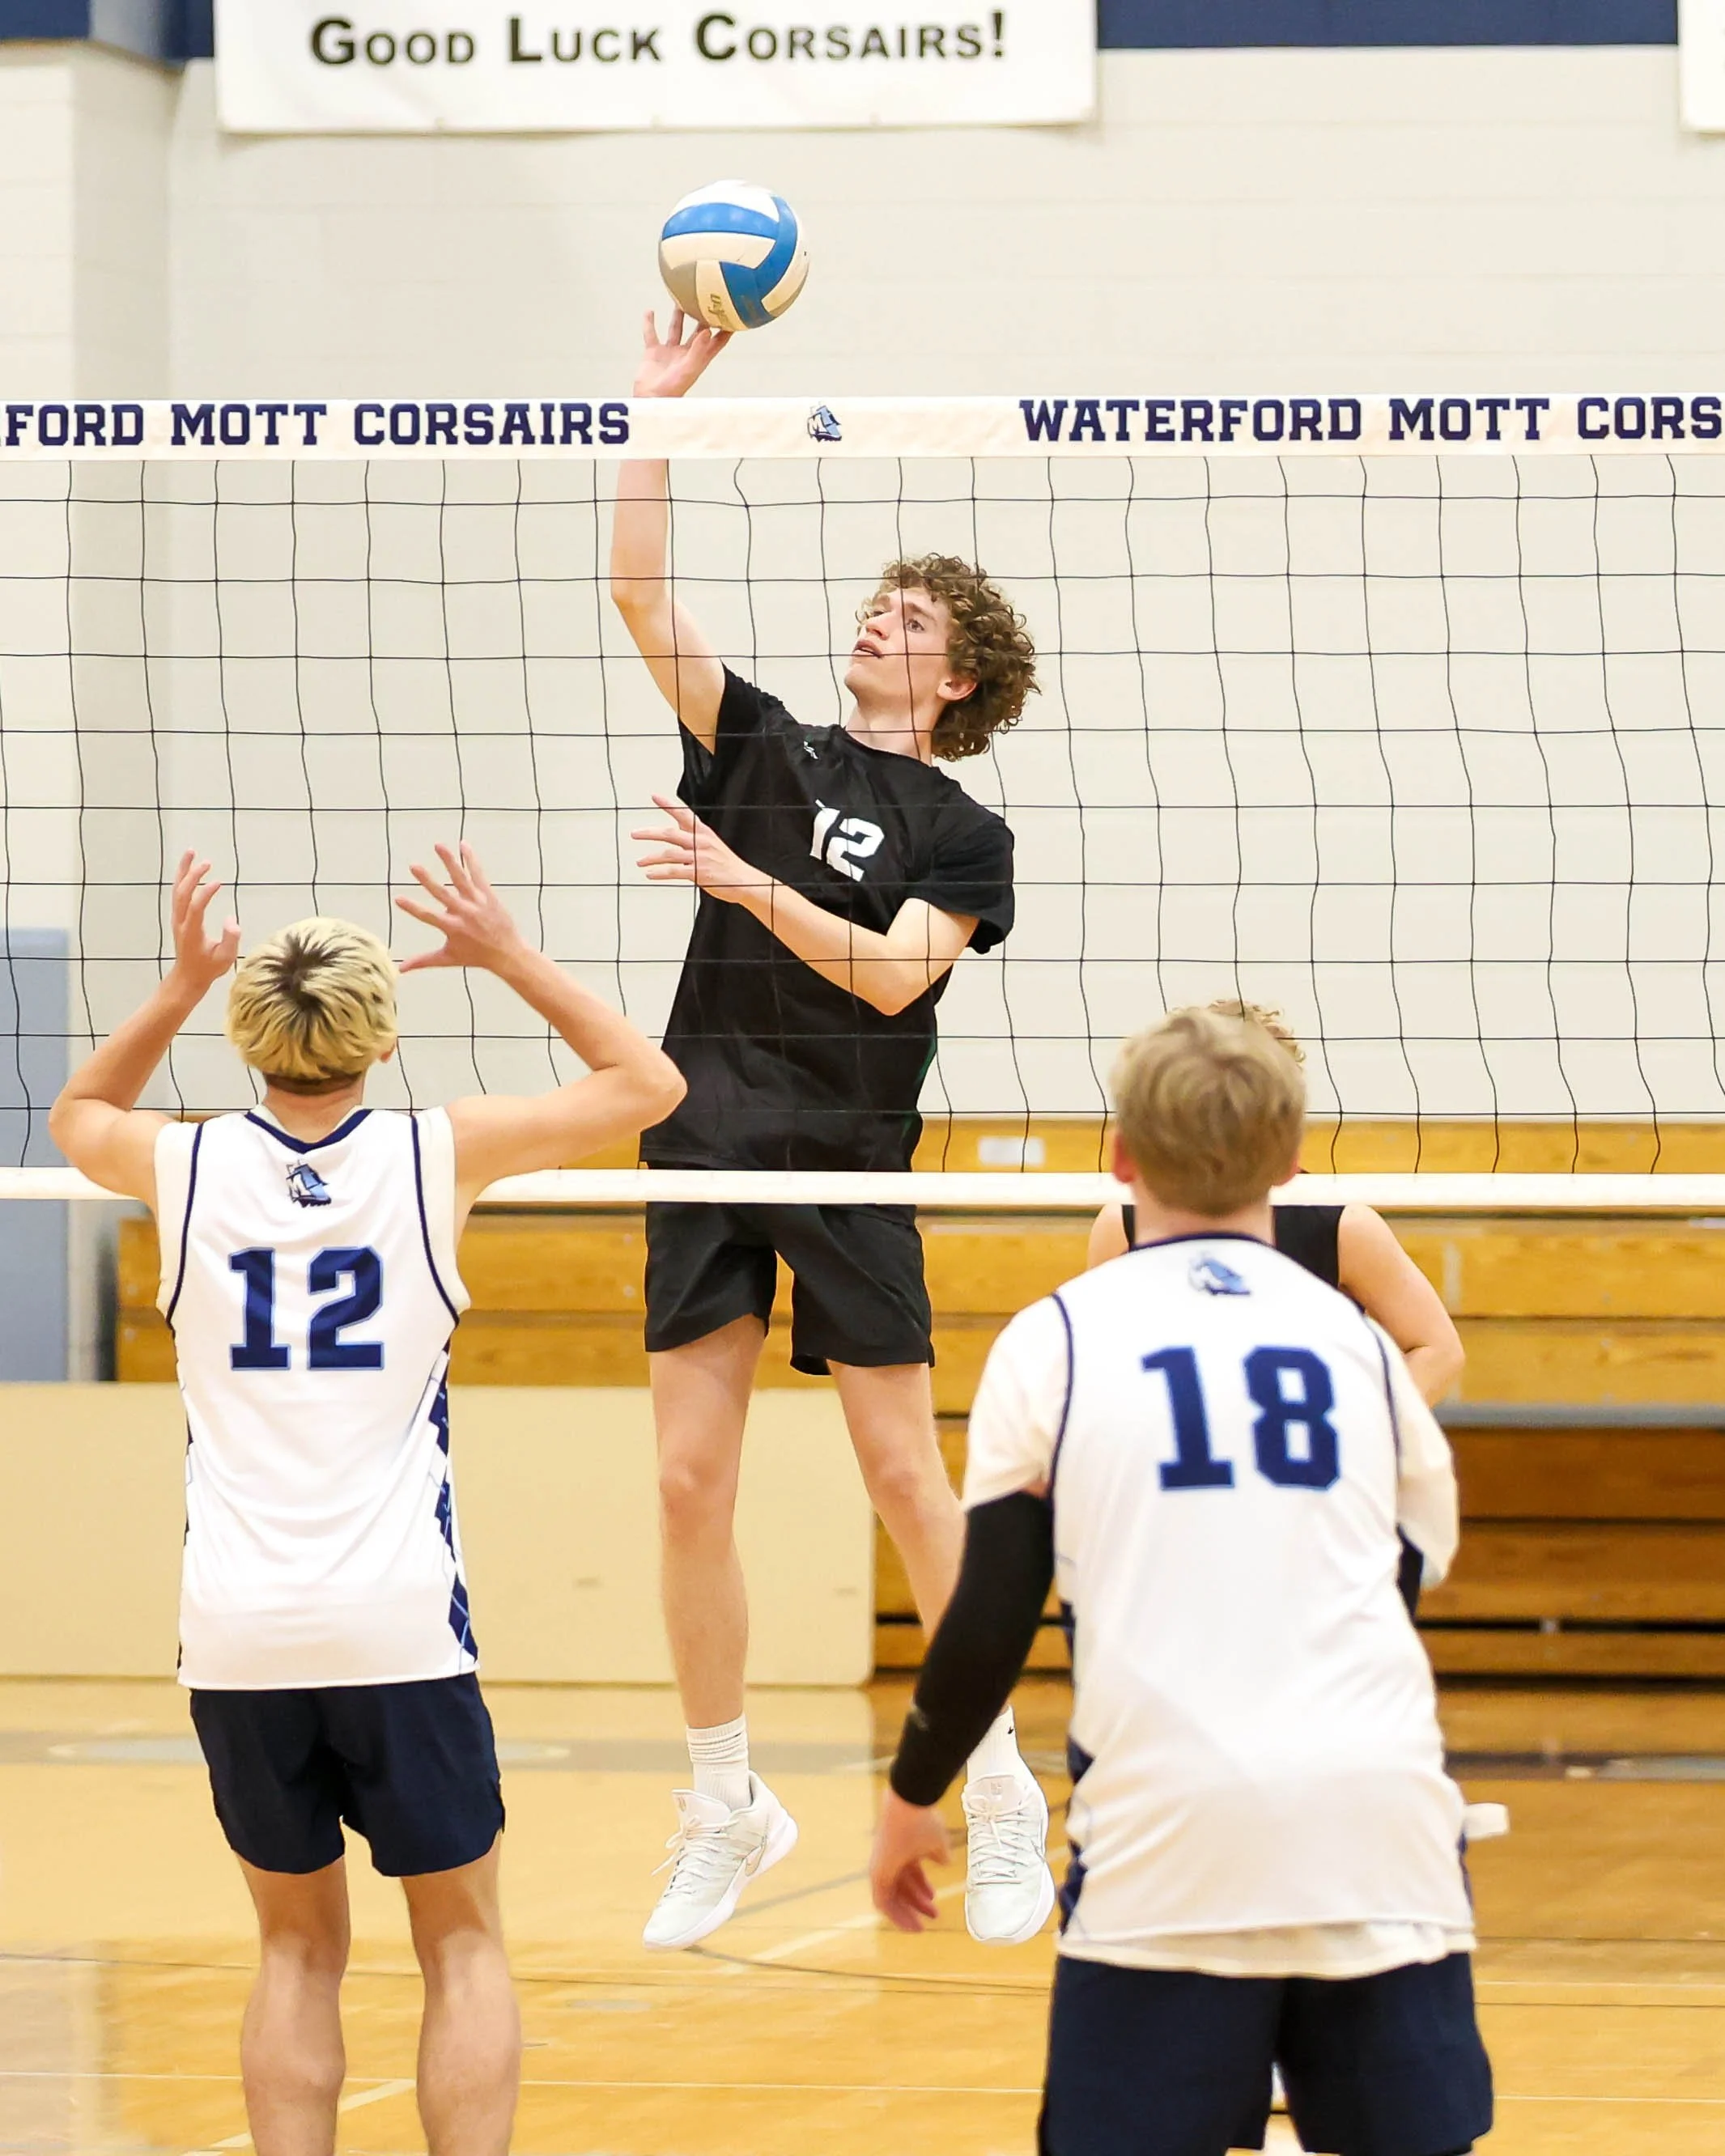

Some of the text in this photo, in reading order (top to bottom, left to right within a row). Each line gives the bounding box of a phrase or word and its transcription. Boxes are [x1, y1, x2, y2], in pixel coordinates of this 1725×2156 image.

[310, 10, 1005, 66] GOOD LUCK CORSAIRS!
[0, 403, 629, 446] FORD MOTT CORSAIRS
[1019, 397, 1723, 442] WATERFORD MOTT CORS
[809, 799, 885, 882] 12
[227, 1246, 385, 1371] 12
[1141, 1345, 1342, 1492] 18
